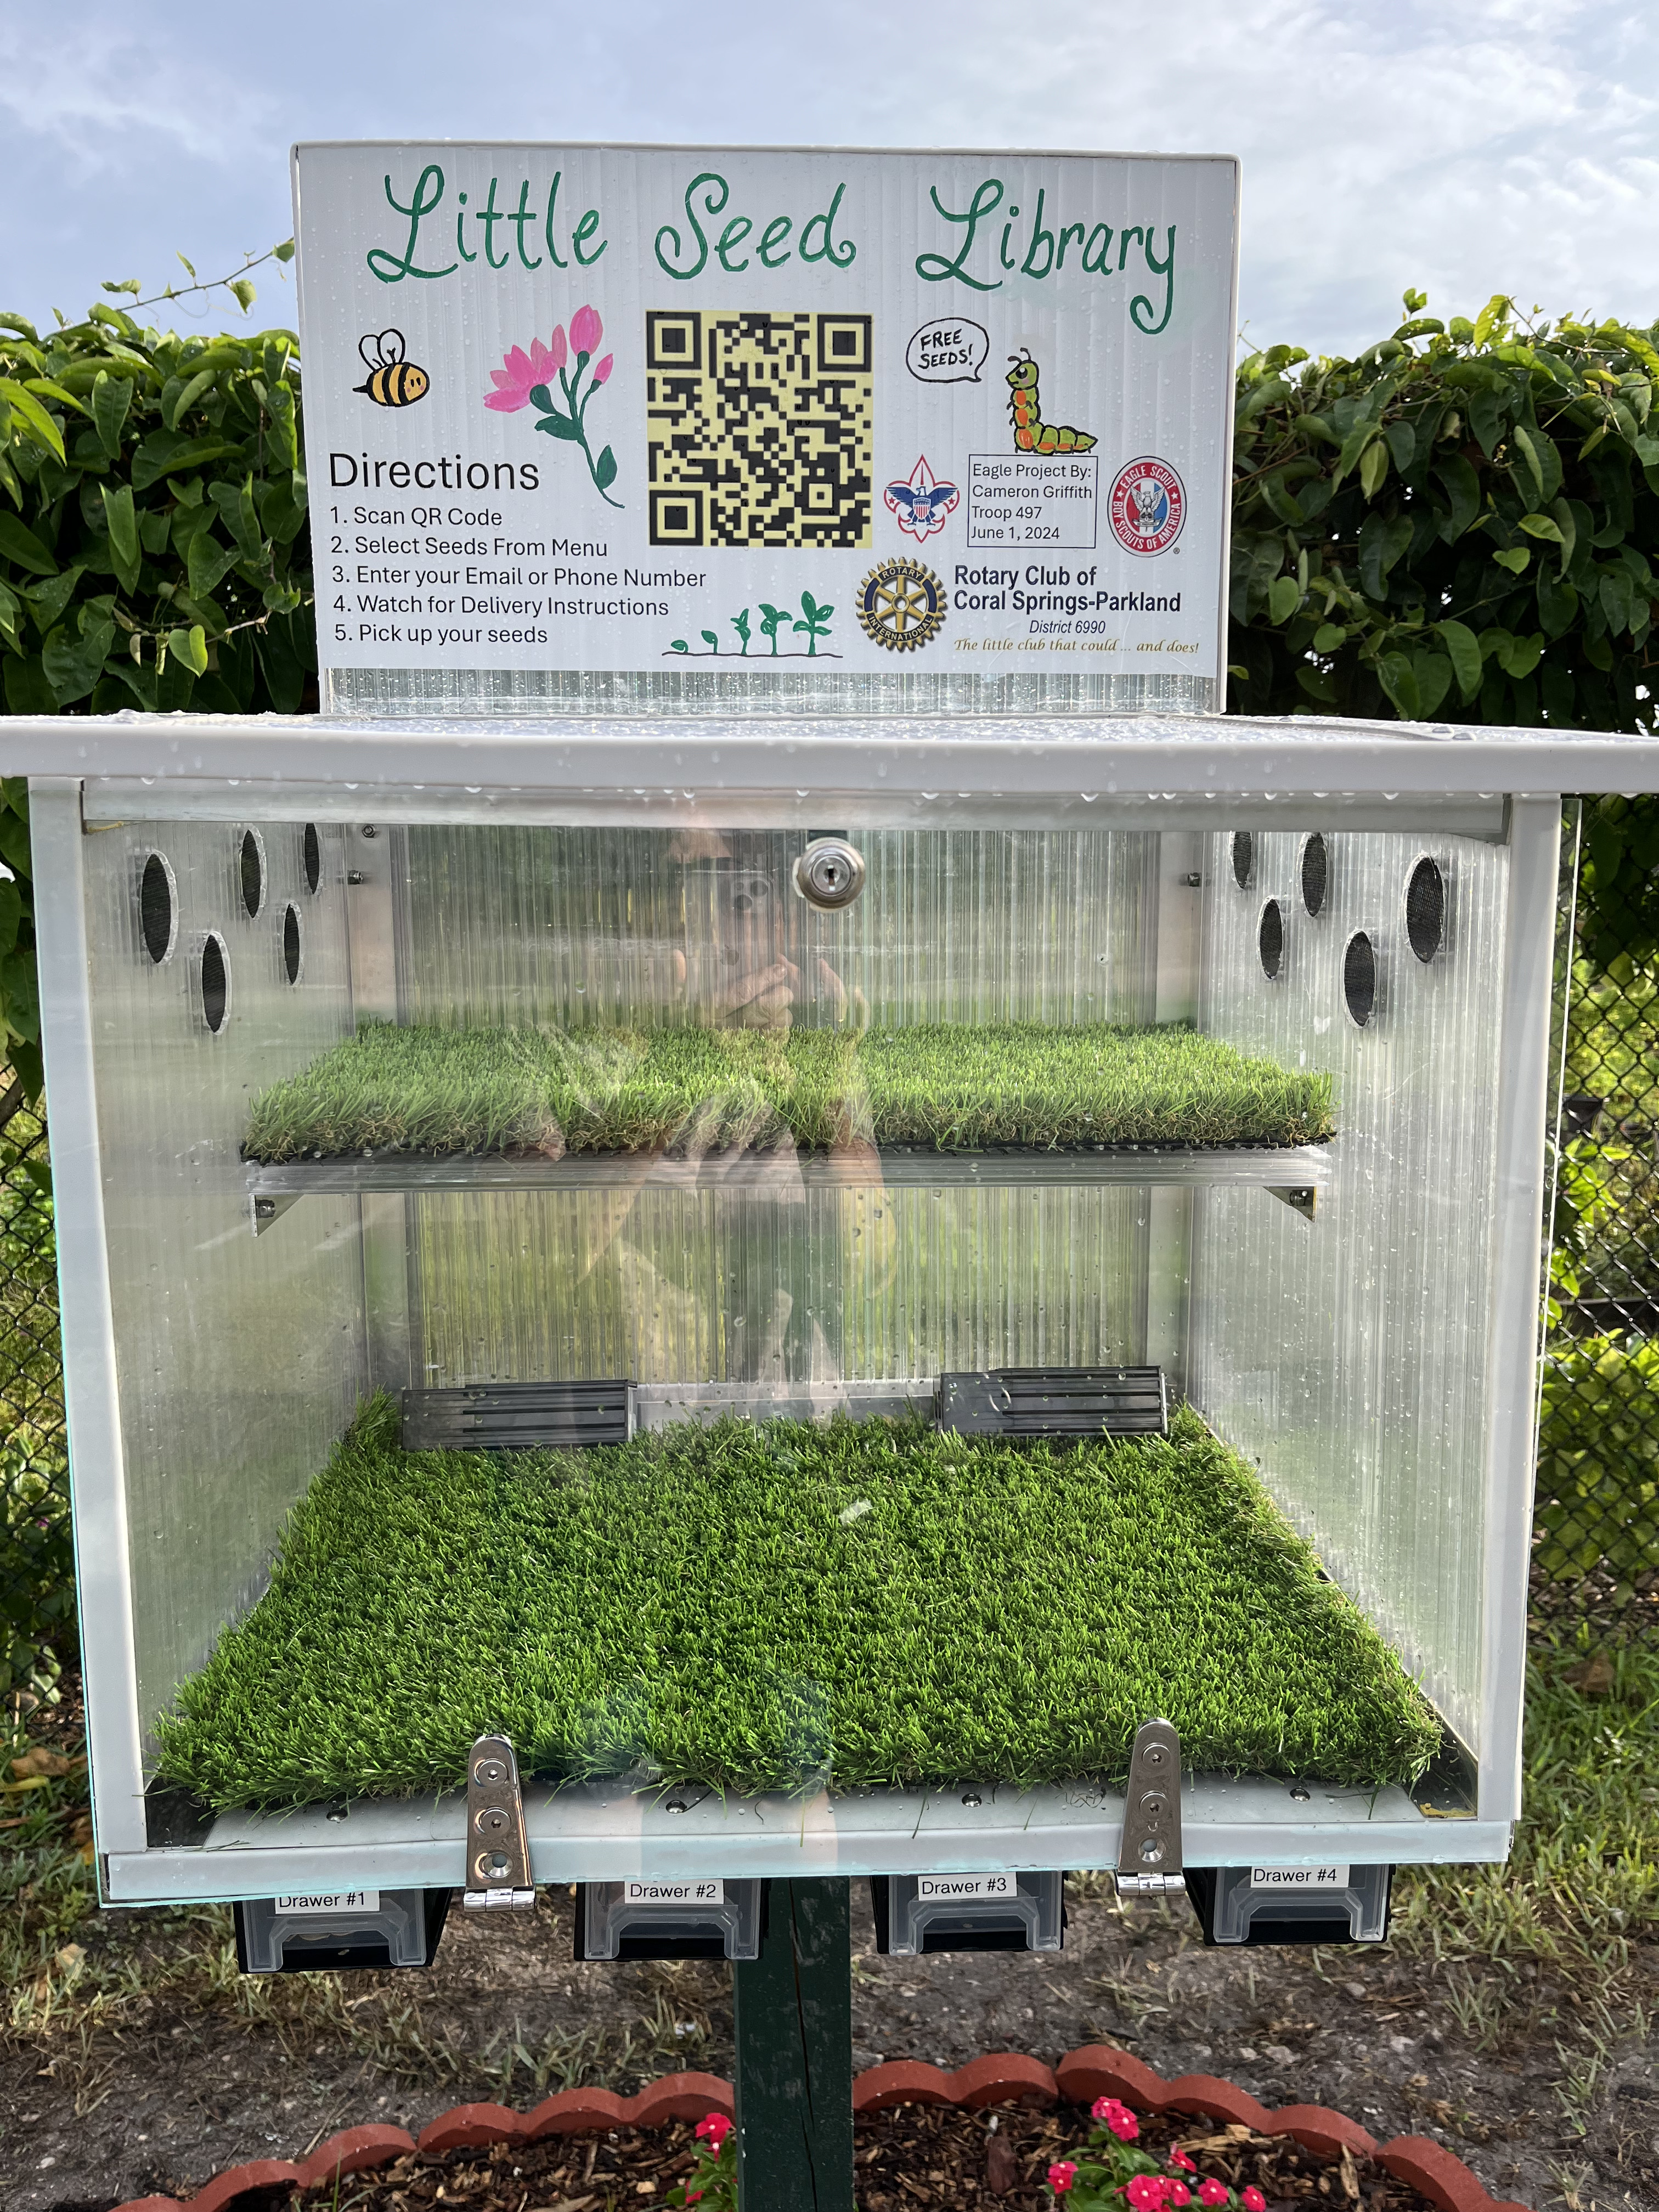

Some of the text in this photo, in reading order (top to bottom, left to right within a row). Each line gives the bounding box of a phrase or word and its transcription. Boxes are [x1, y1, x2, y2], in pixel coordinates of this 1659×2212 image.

[366, 165, 1177, 335] Little Seed Library
[920, 328, 962, 352] FREE
[917, 343, 973, 370] SEEDS!
[330, 452, 539, 490] Directions
[973, 464, 1091, 481] Eagle Project By:
[1120, 465, 1177, 489] EAGLE SCOUT
[973, 484, 1092, 499] Cameron Griffith
[330, 506, 502, 528] 1. Scan QR Code
[971, 506, 1042, 522] Troop 497
[1113, 501, 1180, 549] BOY SCOUTS OF AMERICA
[971, 526, 1060, 541] June 1, 2024
[331, 535, 607, 556] 2. Select Seeds From Menu
[332, 565, 707, 588] 3. Enter your Email or Phone Number
[882, 567, 921, 579] ROTARY
[955, 565, 1097, 590] Rotary Club of
[333, 595, 669, 618] 4. Watch for Delivery Instructions
[954, 590, 1181, 616] Coral Springs-Parkland
[335, 624, 548, 646] 5. Pick up your seeds
[869, 616, 932, 640] INTERNATIONAL
[1029, 620, 1106, 634] District 6990
[955, 640, 980, 651] The
[983, 639, 1013, 651] little
[1018, 639, 1045, 651] club
[1049, 640, 1077, 651] that
[1081, 640, 1116, 651] could
[1137, 640, 1163, 652] and
[1167, 640, 1199, 653] does!
[922, 1877, 1007, 1894] Drawer #3
[1254, 1868, 1337, 1882] Drawer #4
[279, 1892, 364, 1908] Drawer #1
[630, 1884, 716, 1898] Drawer #2
